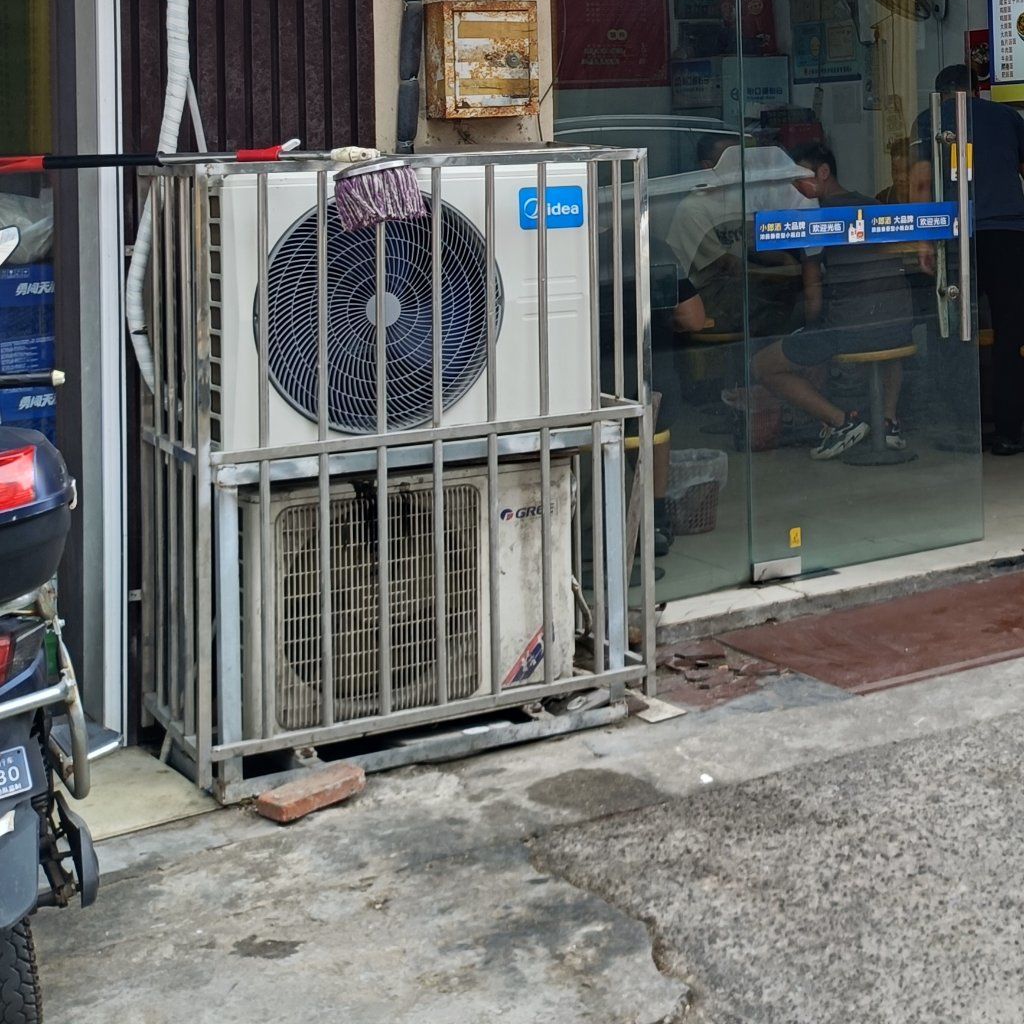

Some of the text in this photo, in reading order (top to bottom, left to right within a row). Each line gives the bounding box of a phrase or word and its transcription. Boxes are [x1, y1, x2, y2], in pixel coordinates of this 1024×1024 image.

[538, 201, 580, 216] idea
[870, 215, 914, 226] 小郎酒 大品牌
[919, 216, 947, 227] 欢迎光临
[759, 221, 806, 232] 小郎酒 大品牌
[812, 222, 842, 233] 欢迎光临
[15, 280, 56, 297] 勇闯天
[18, 393, 56, 410] 勇闯天
